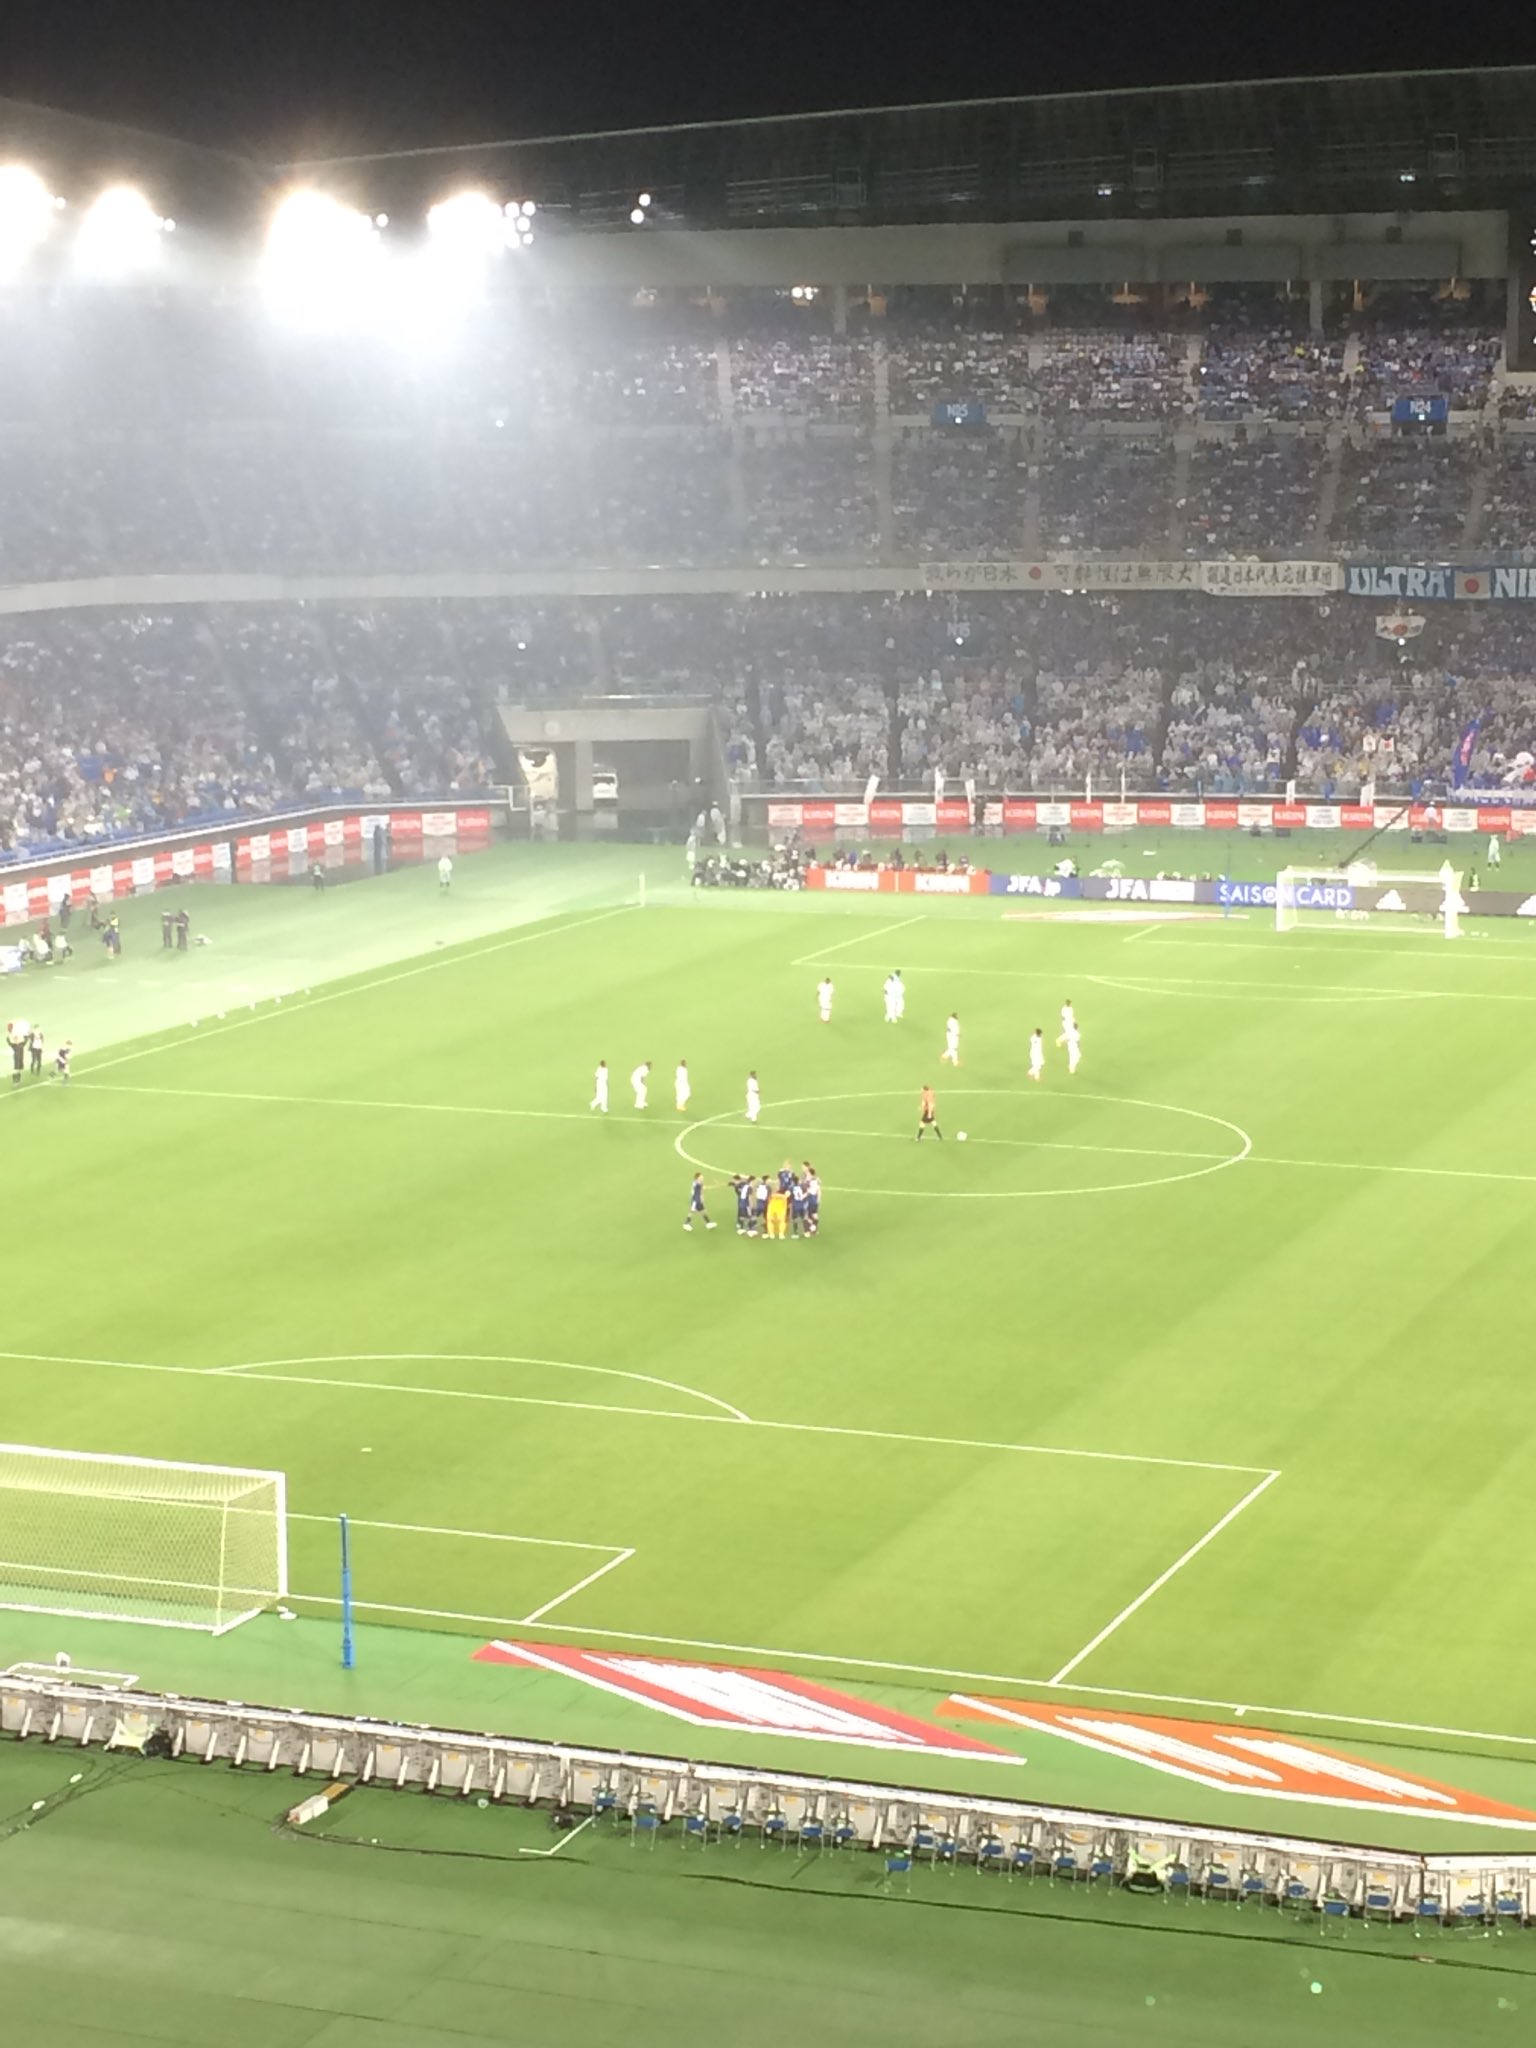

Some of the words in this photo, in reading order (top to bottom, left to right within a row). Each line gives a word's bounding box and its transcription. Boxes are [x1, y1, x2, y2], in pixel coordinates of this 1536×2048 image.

[1106, 878, 1148, 900] JFA
[1220, 884, 1294, 905] SAISON
[1297, 886, 1352, 907] CARD
